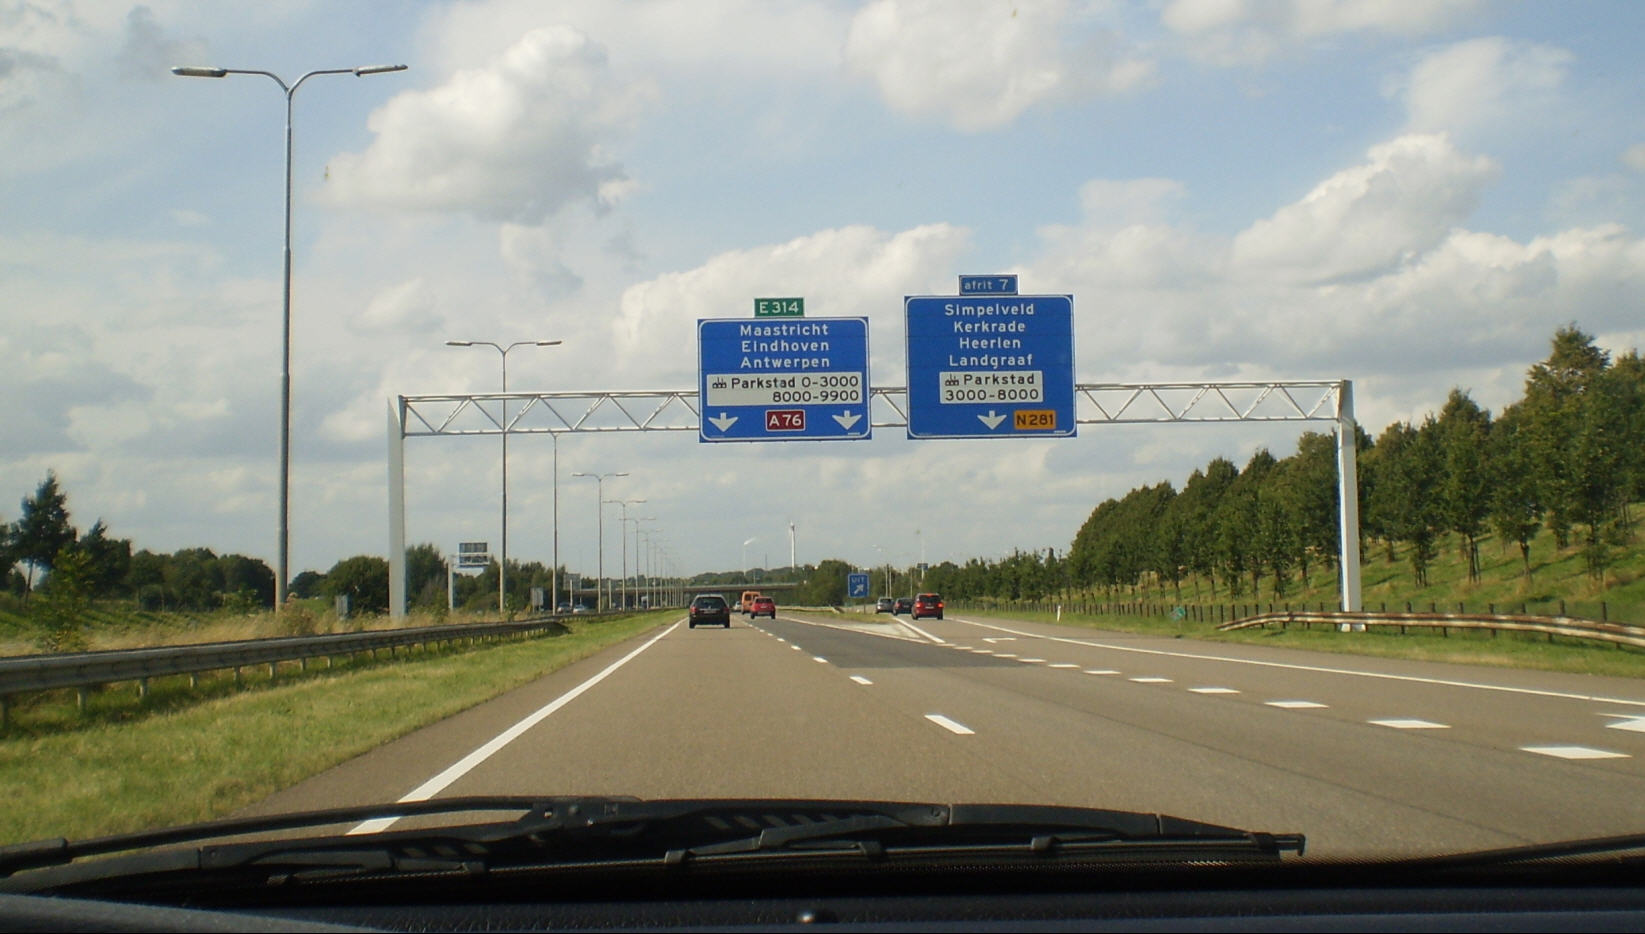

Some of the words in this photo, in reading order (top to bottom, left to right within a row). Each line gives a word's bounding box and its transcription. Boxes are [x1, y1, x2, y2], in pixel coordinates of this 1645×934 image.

[964, 279, 993, 291] afrit
[999, 278, 1009, 290] 7
[944, 303, 1035, 318] Simpelveld
[740, 324, 829, 336] Maastricht
[954, 320, 1026, 332] Kerkrade
[741, 340, 830, 353] Eindhoven
[959, 337, 1022, 349] Heerlen
[740, 356, 831, 369] Antwerpen
[949, 354, 1033, 369] Landgraaf
[731, 376, 796, 389] Parkstad
[801, 375, 859, 388] 0-3000
[963, 373, 1035, 386] Parkstad
[772, 390, 859, 403] 8000-9900
[944, 388, 1039, 402] 3000-8000
